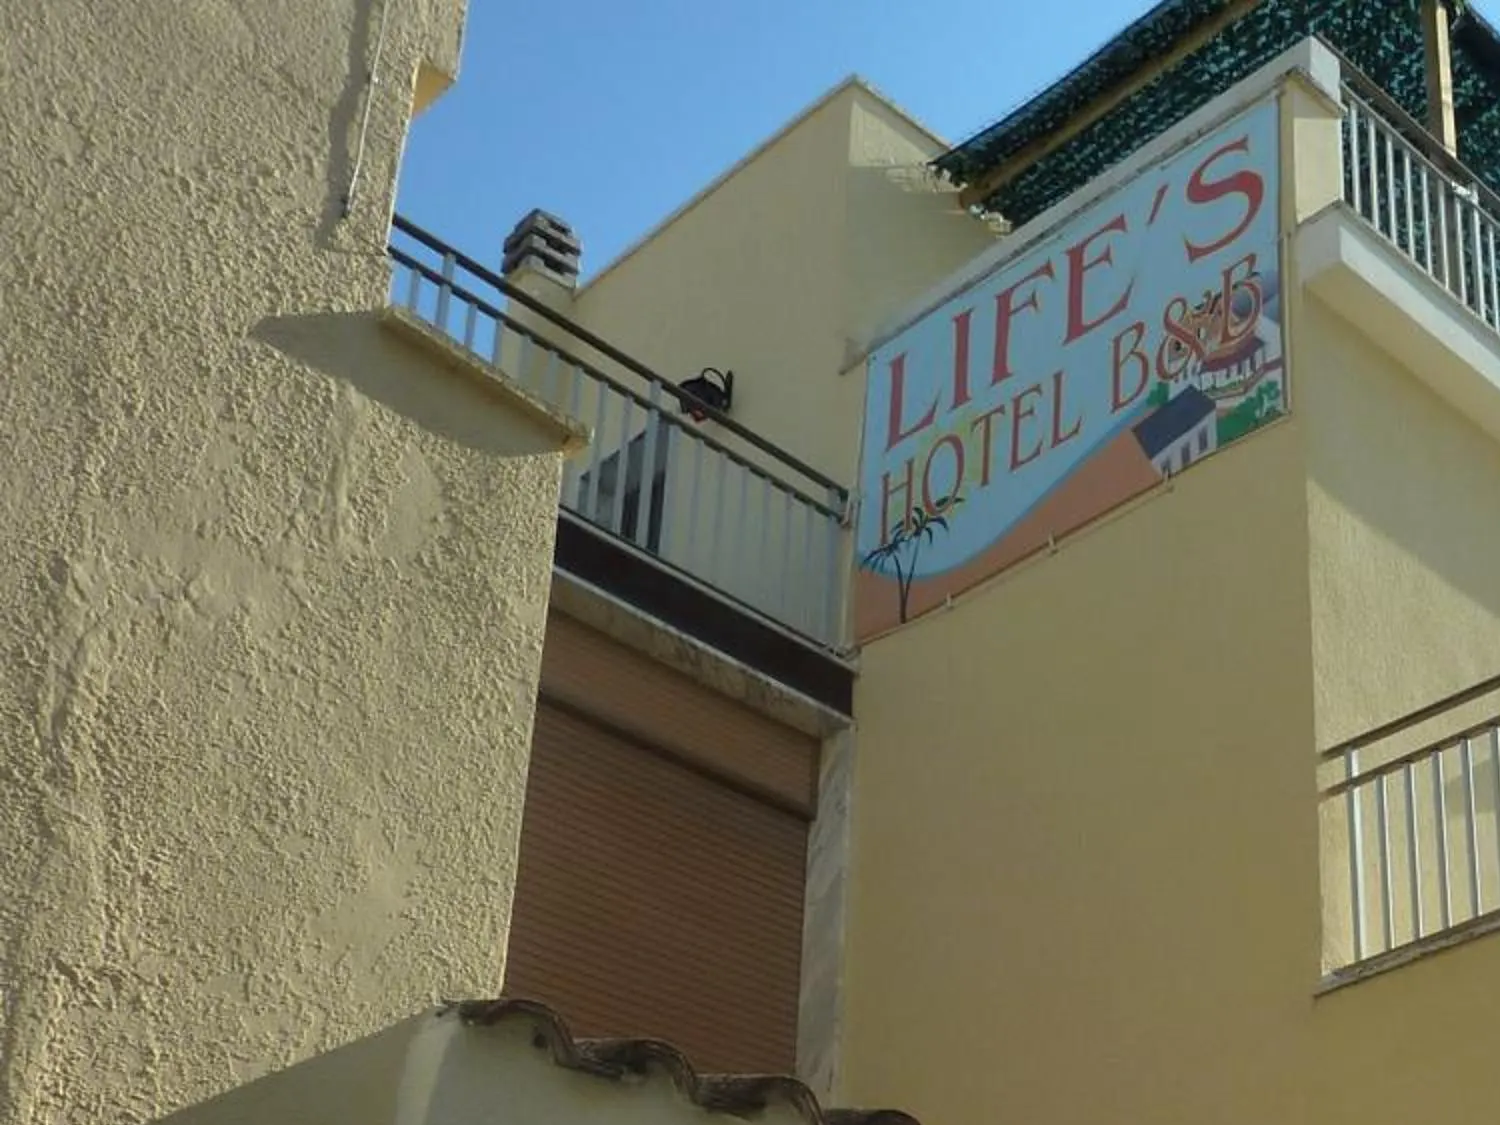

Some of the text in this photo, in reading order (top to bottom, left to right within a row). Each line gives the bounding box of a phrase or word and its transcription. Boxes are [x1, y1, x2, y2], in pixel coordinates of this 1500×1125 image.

[879, 253, 1264, 547] HOTEL B&B
[884, 133, 1265, 453] LIFE'S
